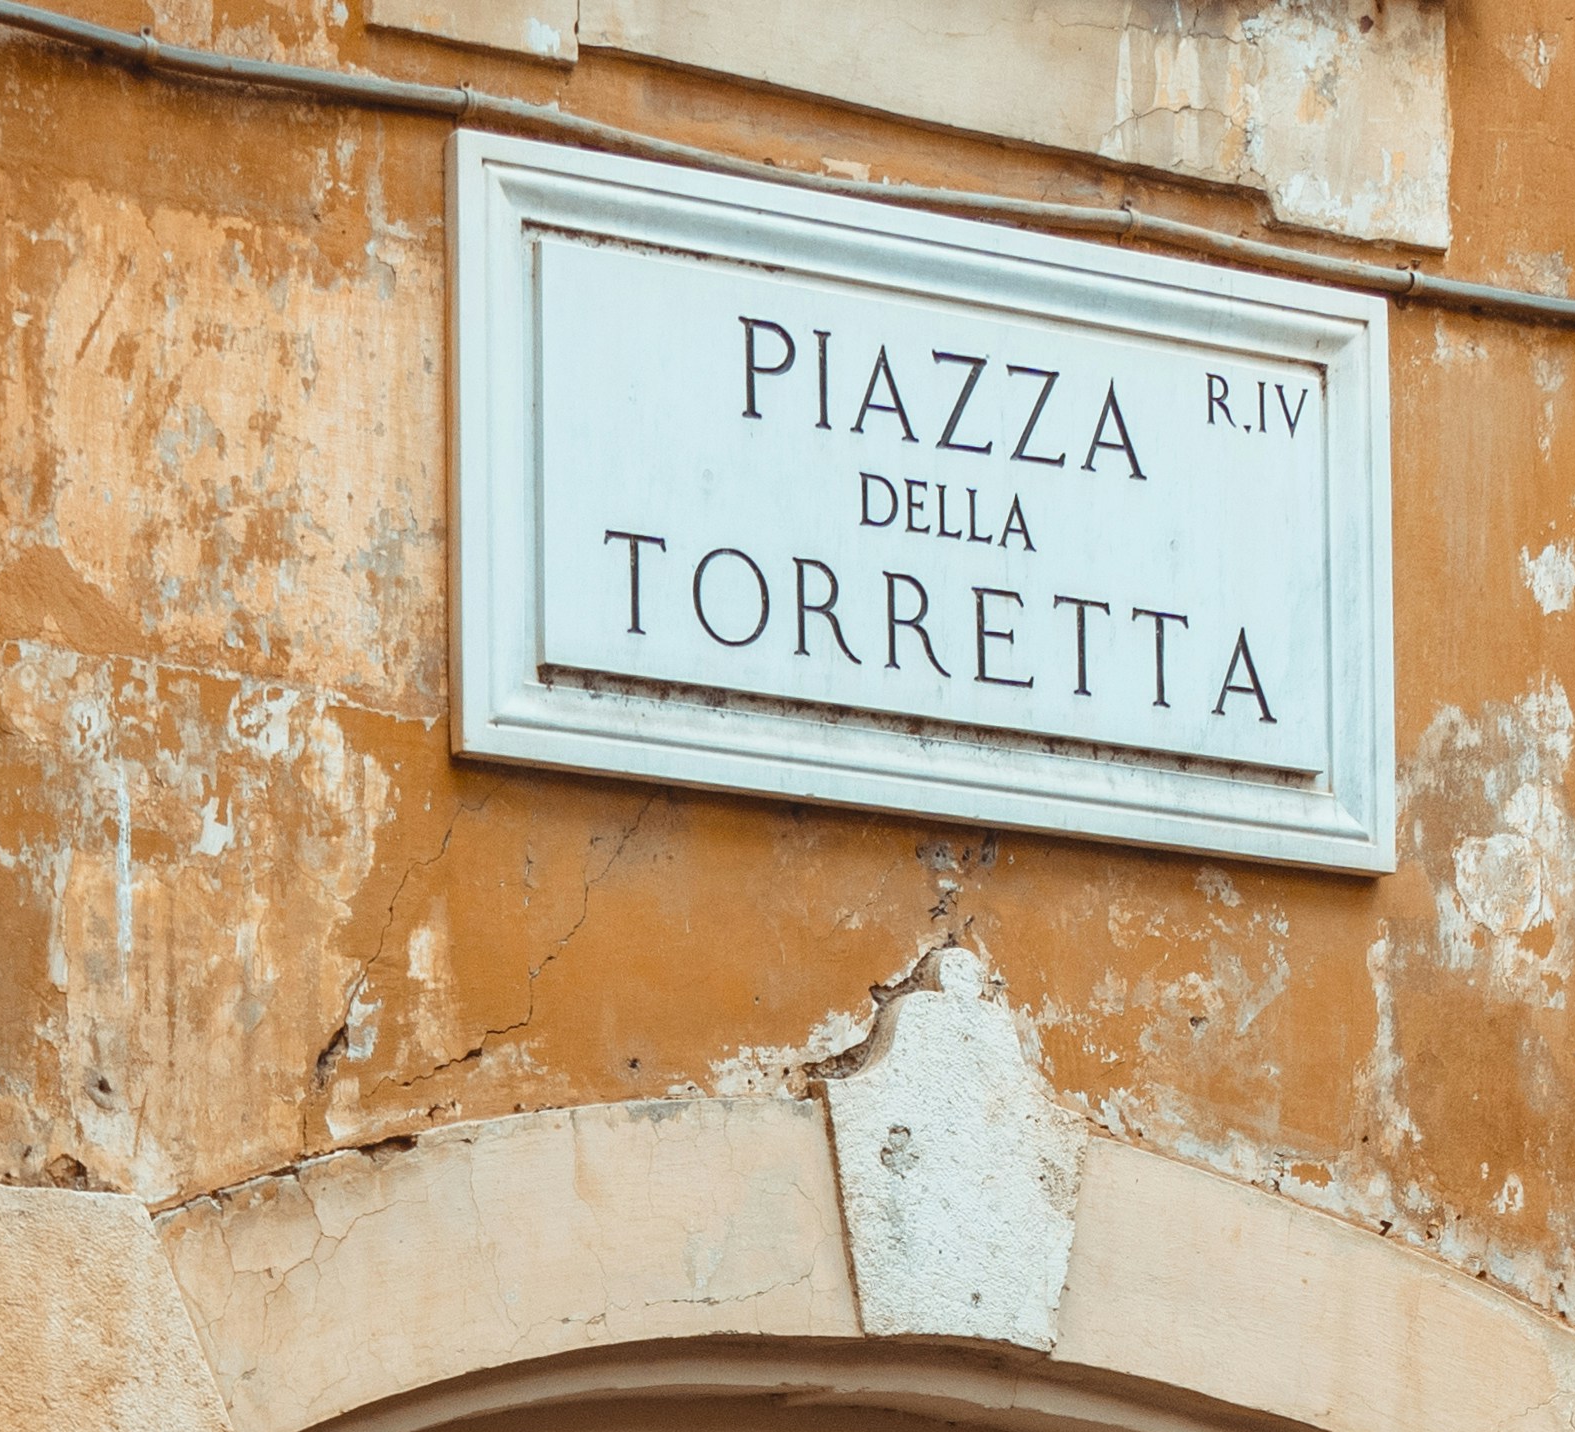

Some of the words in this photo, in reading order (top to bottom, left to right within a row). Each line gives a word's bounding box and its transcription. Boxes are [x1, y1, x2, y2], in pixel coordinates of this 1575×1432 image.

[738, 315, 1147, 480] PIAZZA
[1205, 370, 1309, 439] R.IV
[858, 471, 1037, 552] DELLA
[604, 529, 1277, 724] TORRETTA
